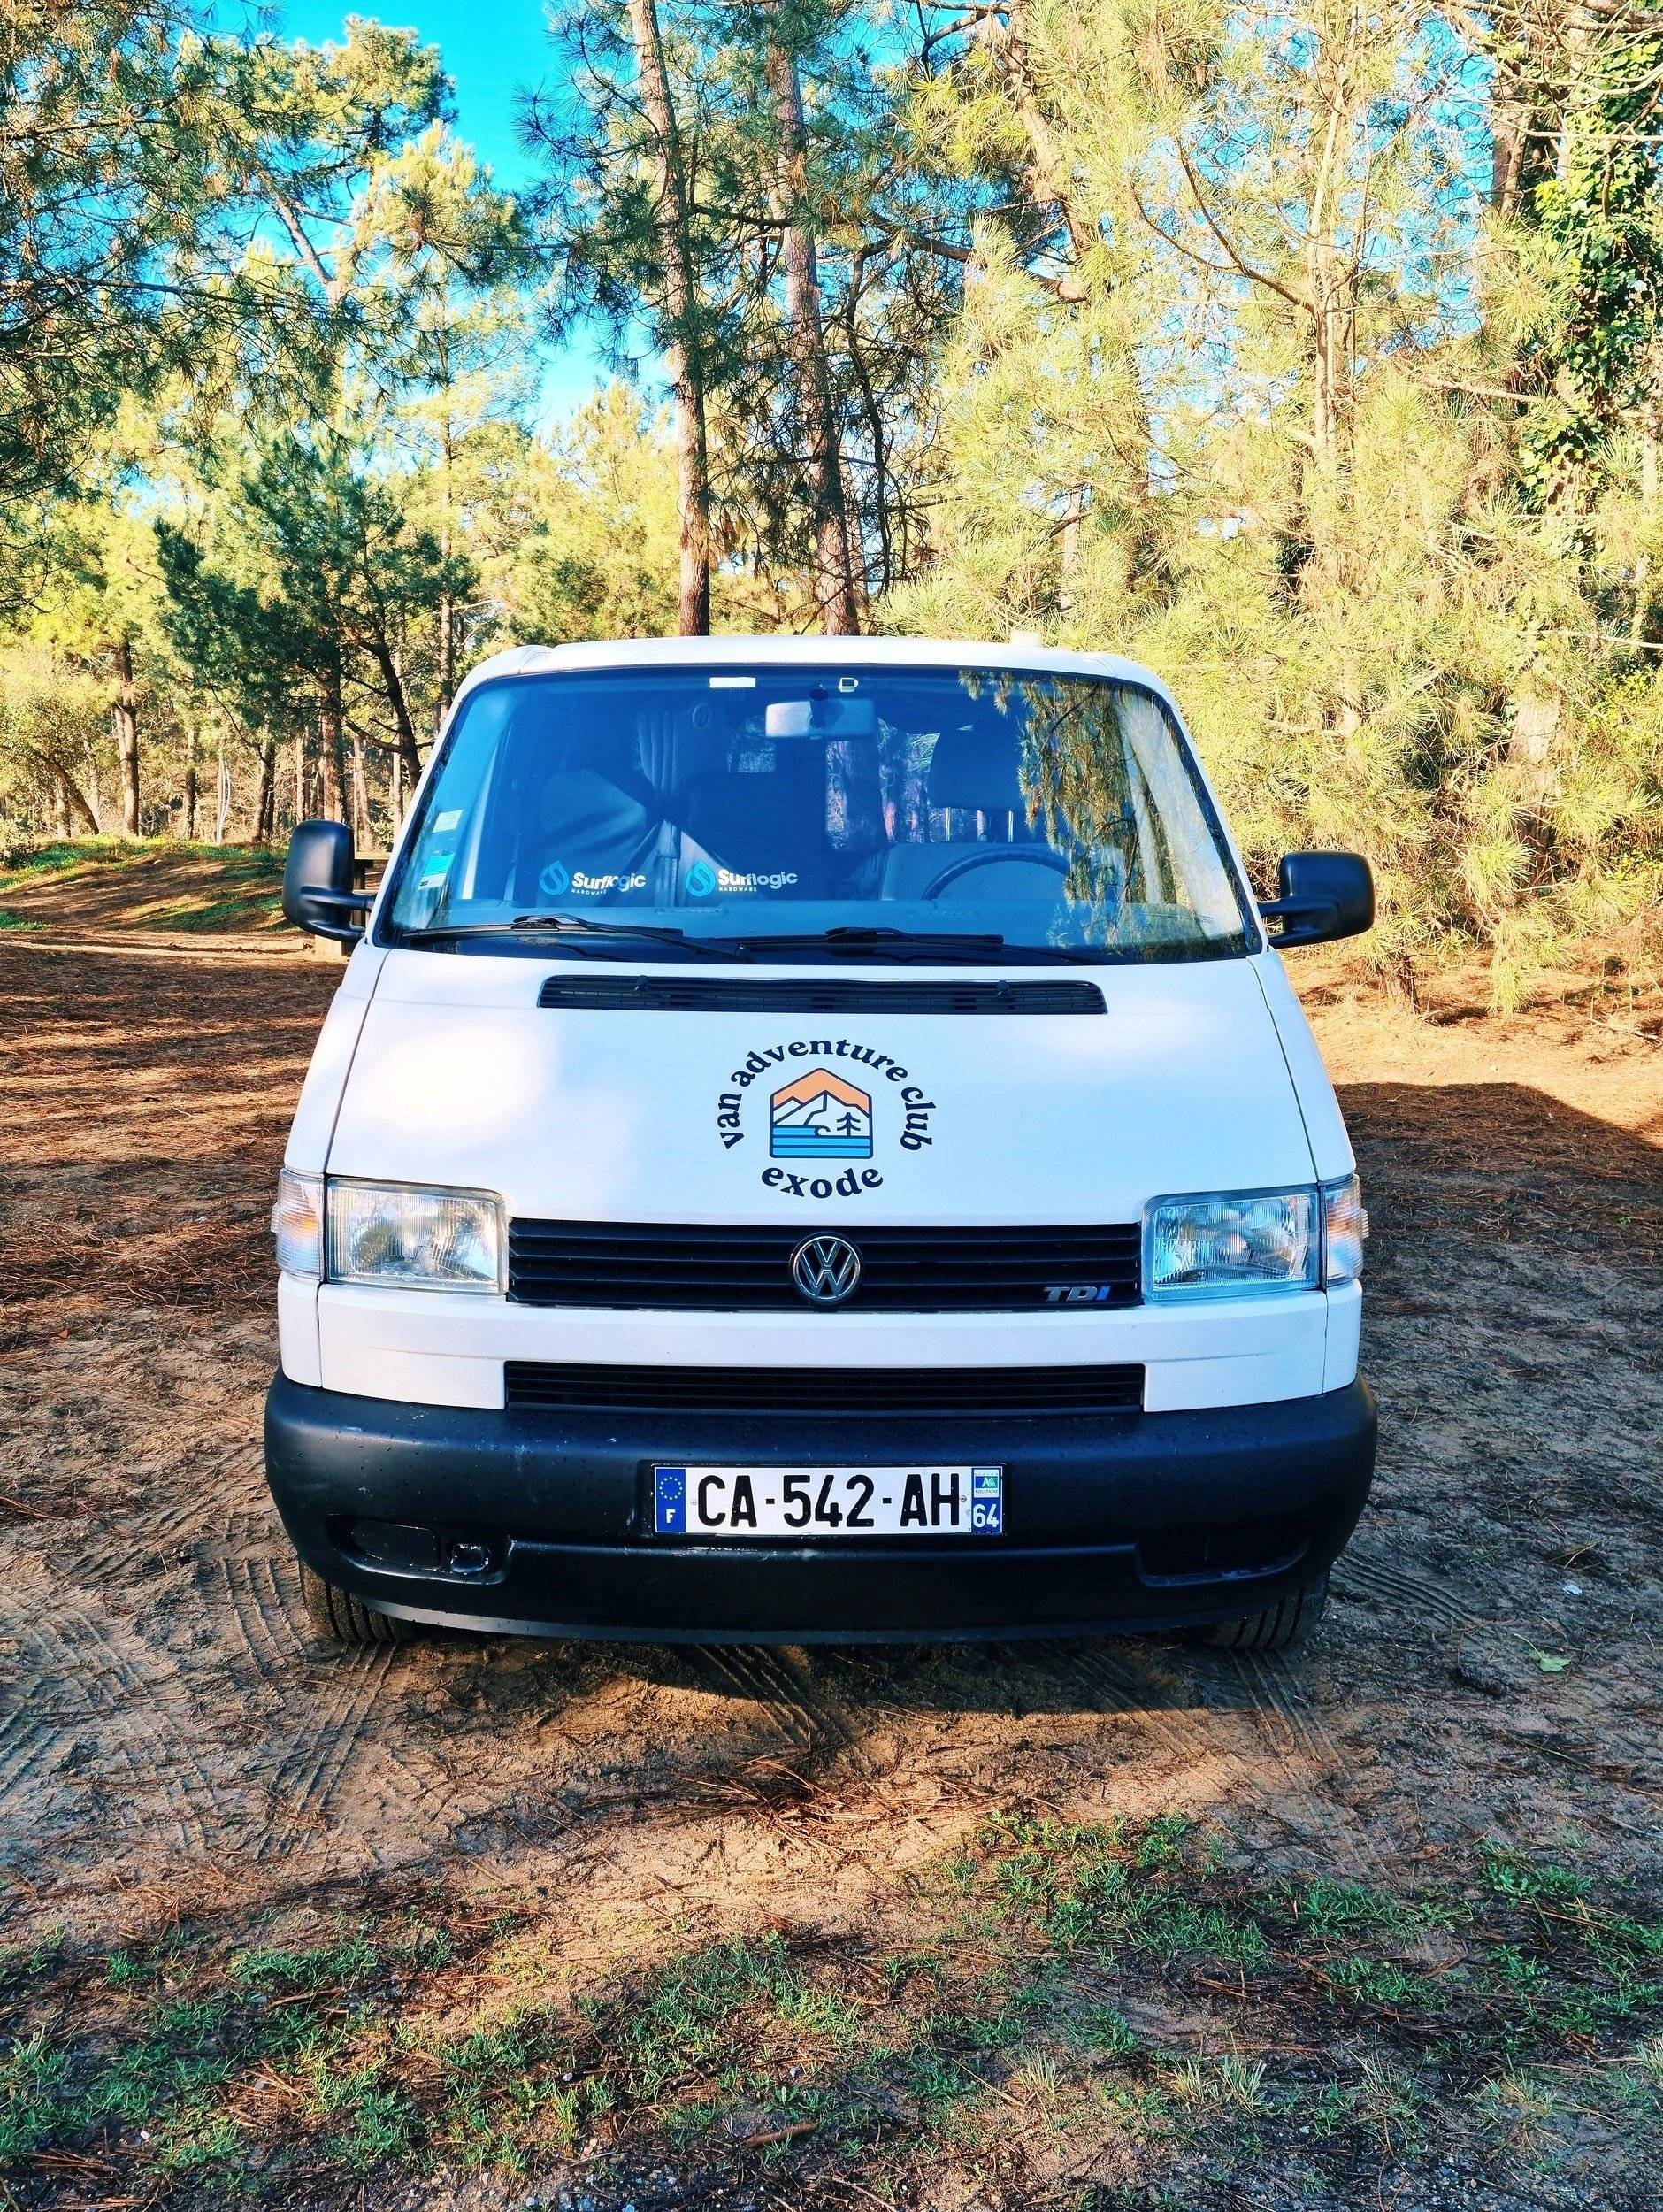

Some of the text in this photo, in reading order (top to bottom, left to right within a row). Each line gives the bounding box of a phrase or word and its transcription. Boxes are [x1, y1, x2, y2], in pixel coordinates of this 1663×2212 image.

[717, 869, 798, 889] Surflogic
[717, 1039, 936, 1151] van adventure club
[761, 1167, 884, 1199] exode
[794, 1235, 861, 1300] VW
[1043, 1286, 1112, 1302] TDI
[697, 1473, 960, 1528] CA-542-AH
[666, 1509, 676, 1523] F
[973, 1503, 999, 1528] 64
